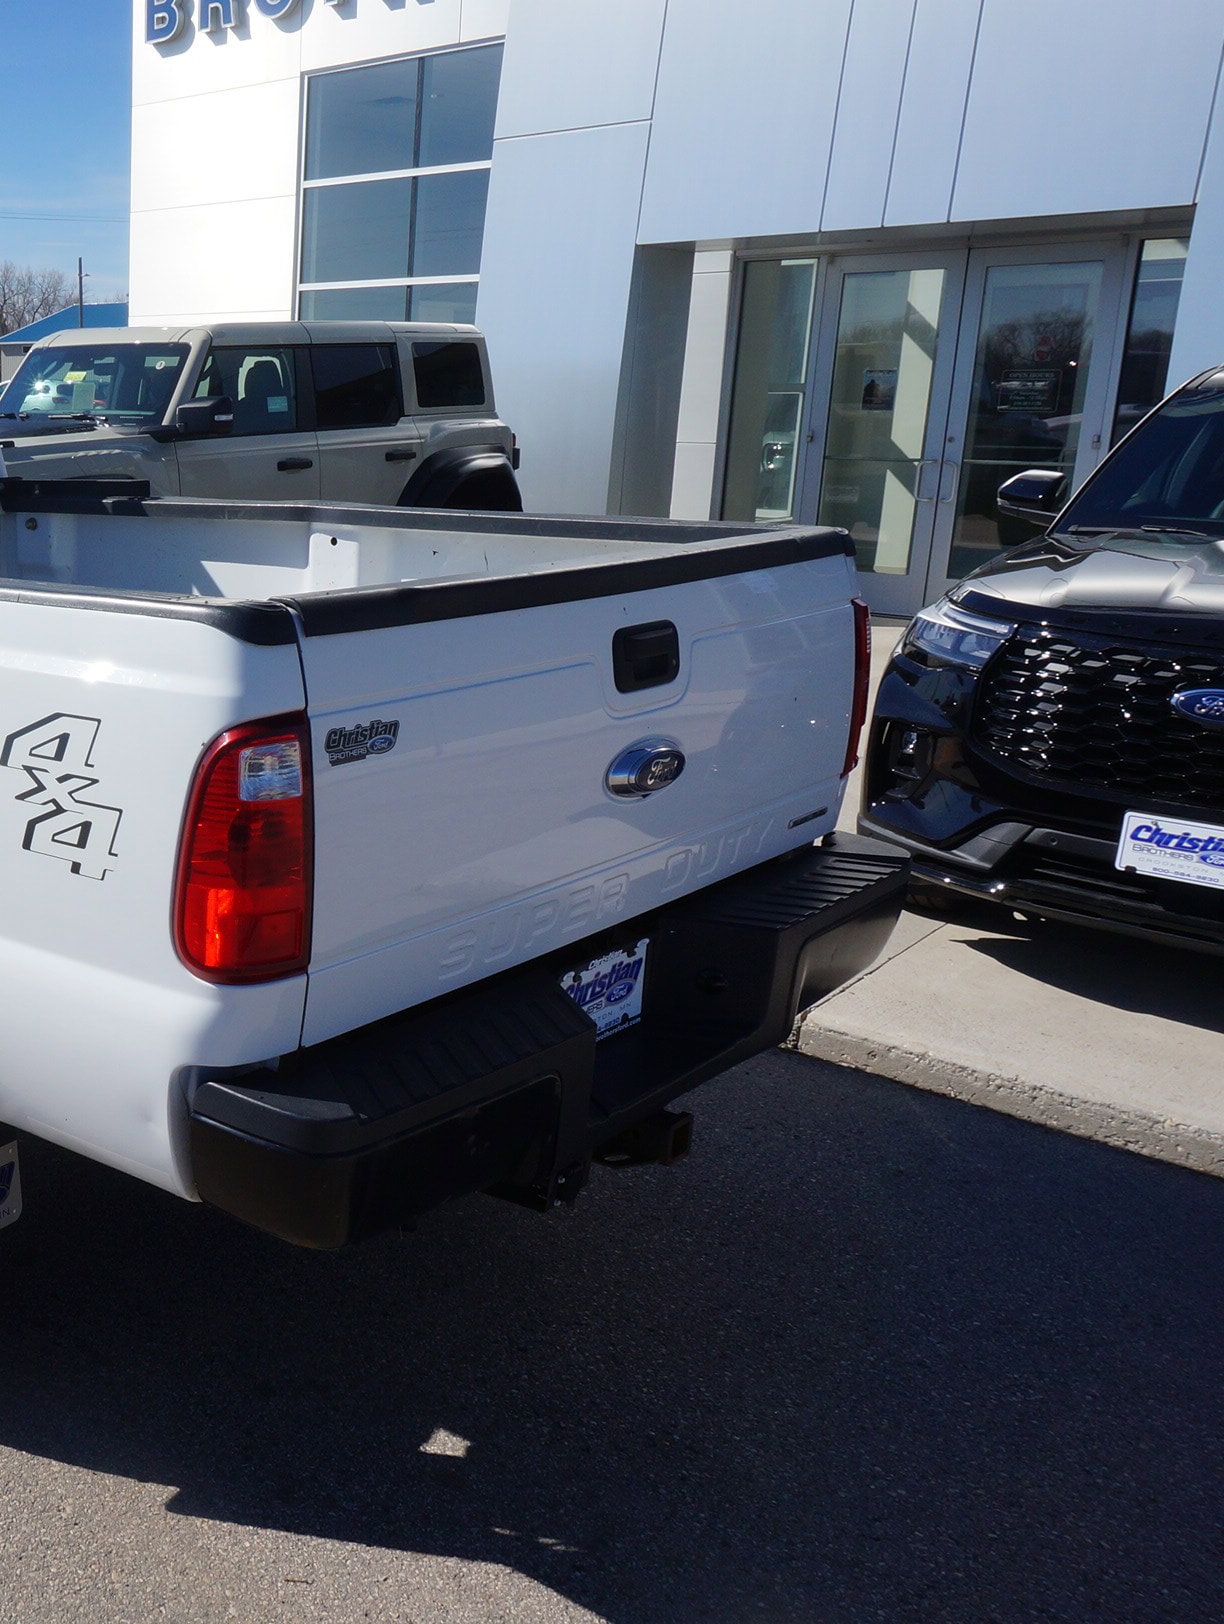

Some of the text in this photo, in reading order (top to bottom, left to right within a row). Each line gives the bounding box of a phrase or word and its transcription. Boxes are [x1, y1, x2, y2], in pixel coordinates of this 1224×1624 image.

[324, 720, 399, 752] Christian
[329, 747, 368, 761] BROTHERS
[646, 757, 679, 785] Ford
[1132, 843, 1194, 861] BROTHERS
[438, 817, 775, 980] SUPER DUTY
